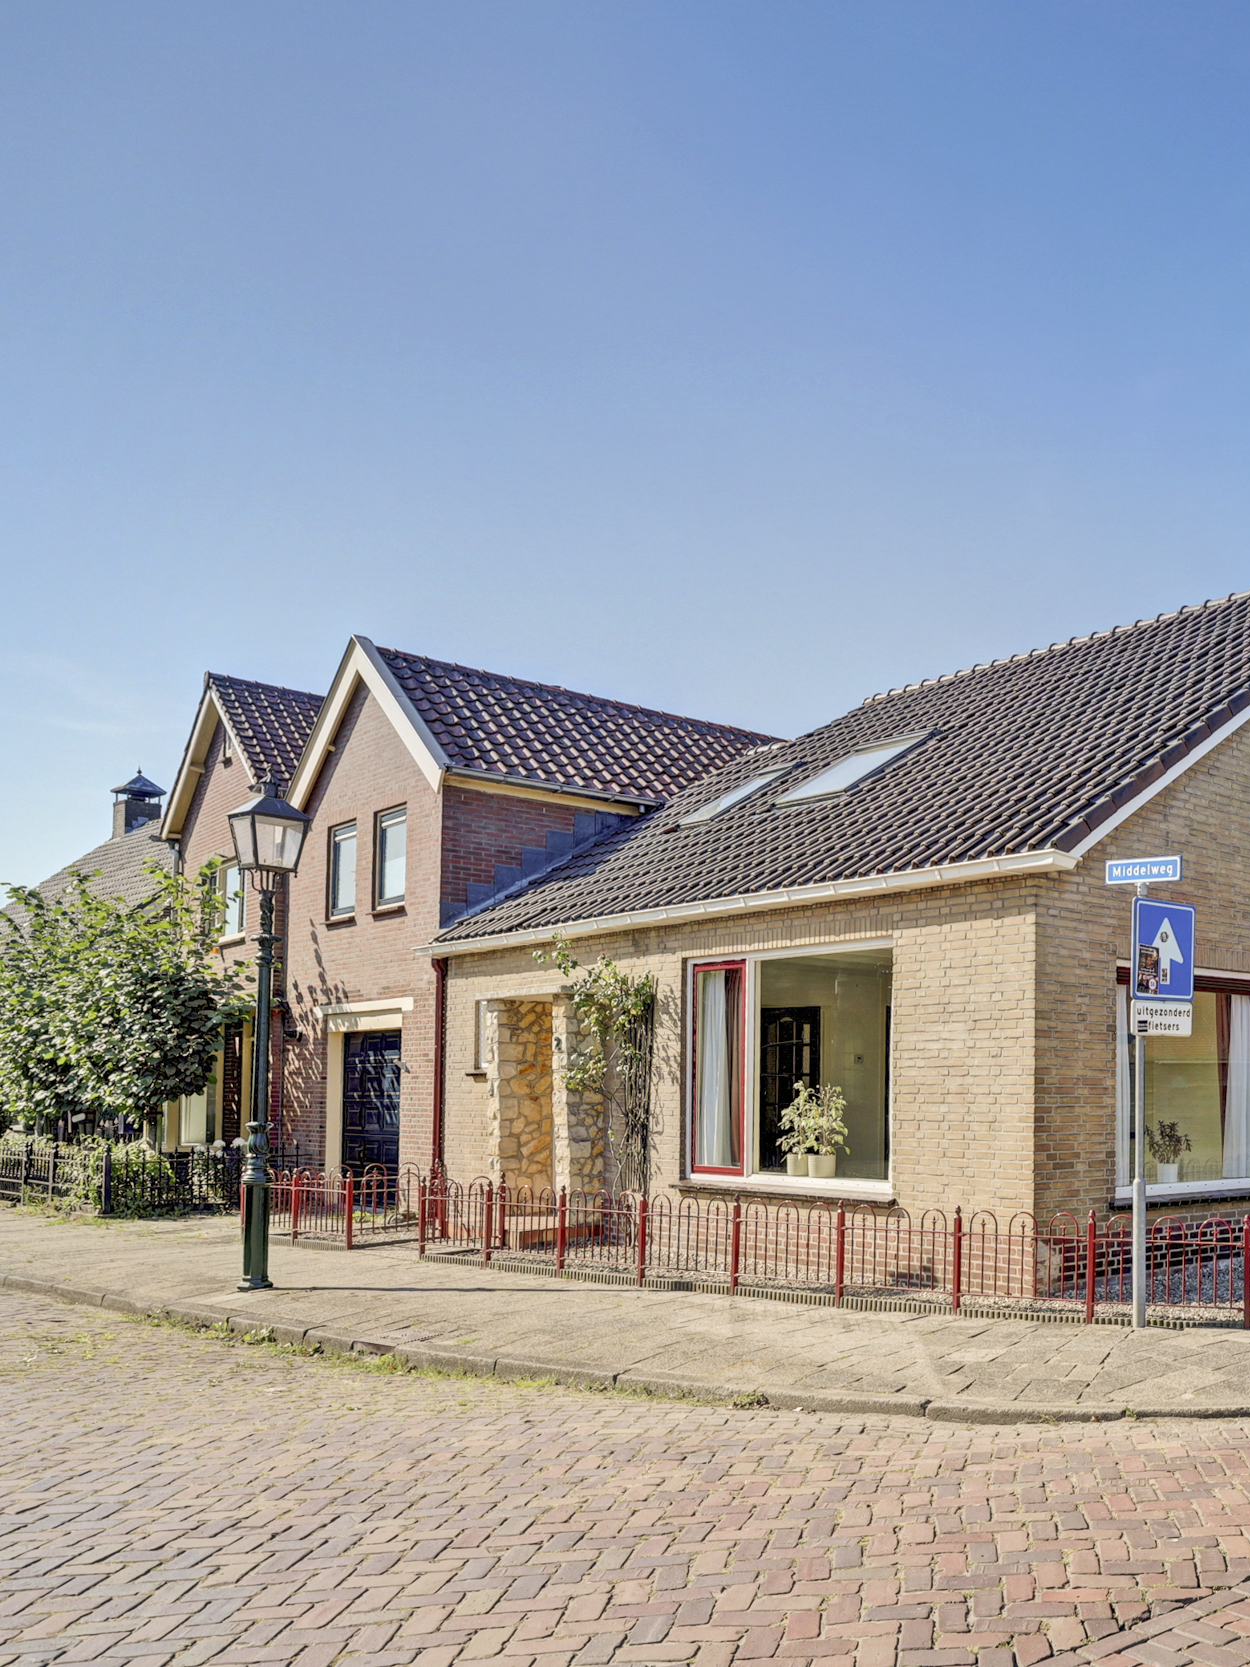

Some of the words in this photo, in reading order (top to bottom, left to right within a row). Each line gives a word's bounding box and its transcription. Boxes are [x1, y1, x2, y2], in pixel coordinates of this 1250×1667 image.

[1112, 864, 1173, 877] Middelweg
[1136, 1005, 1191, 1019] uitgezonderd
[1148, 1020, 1180, 1031] fietsers
